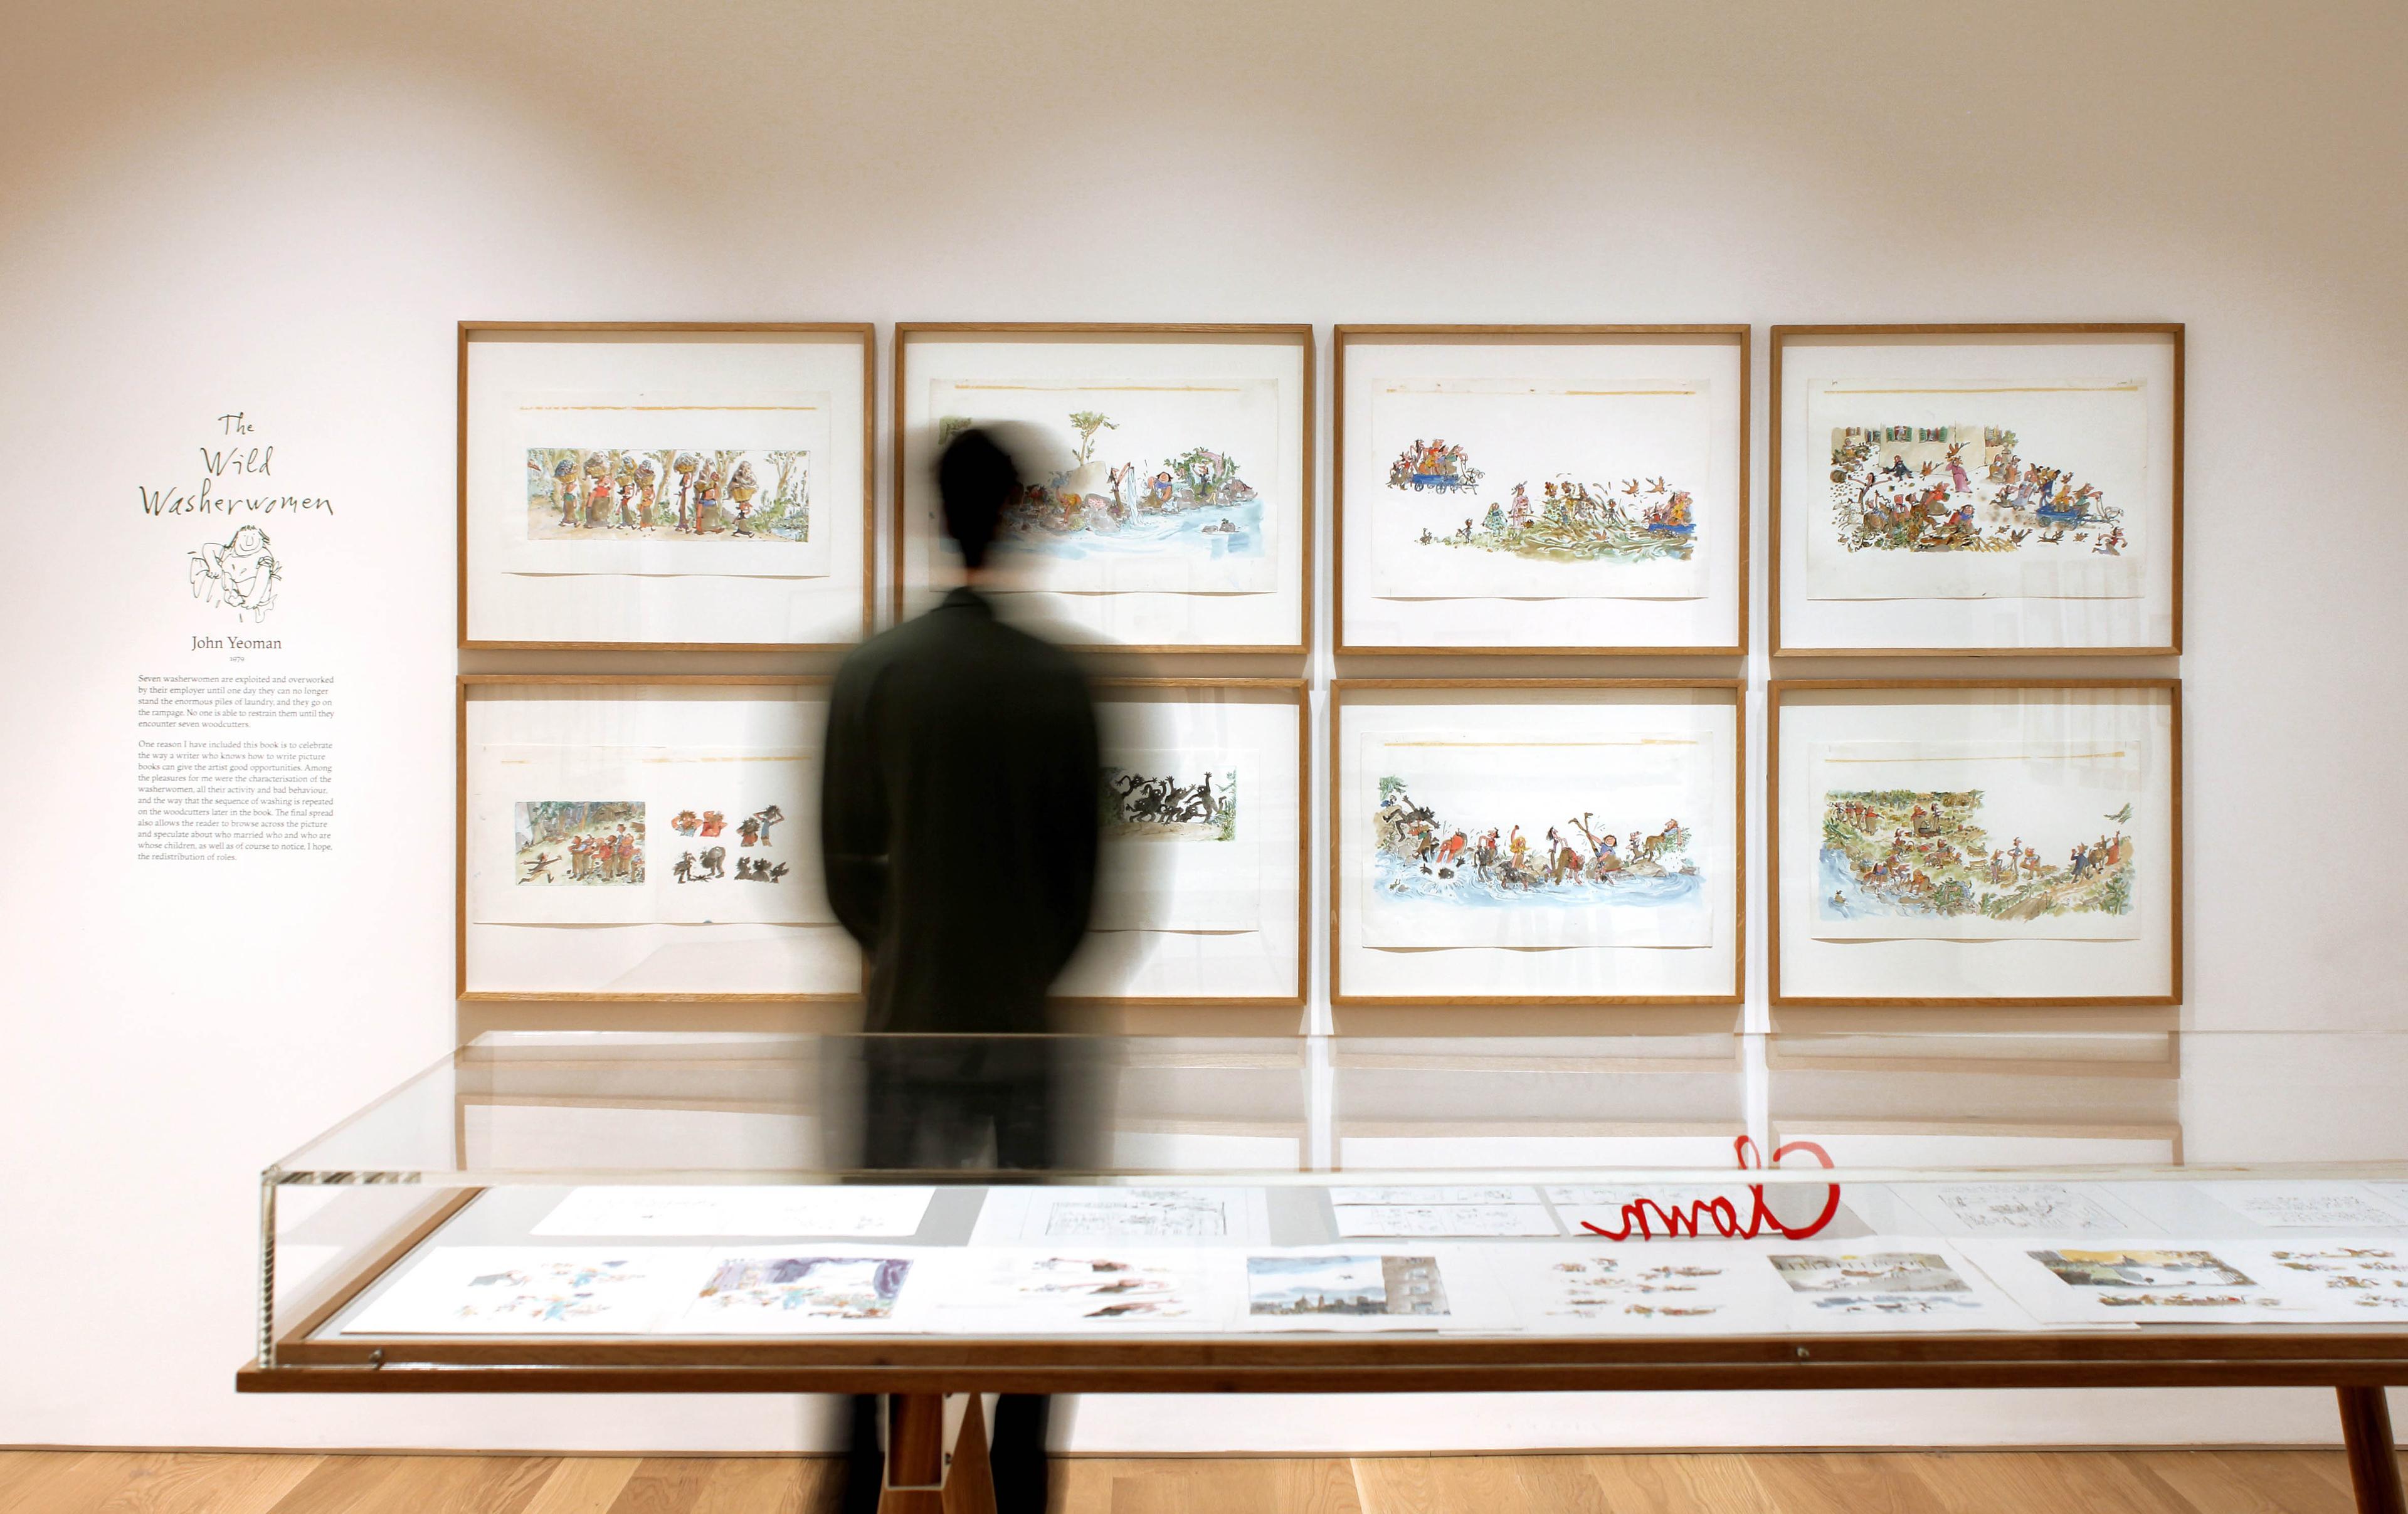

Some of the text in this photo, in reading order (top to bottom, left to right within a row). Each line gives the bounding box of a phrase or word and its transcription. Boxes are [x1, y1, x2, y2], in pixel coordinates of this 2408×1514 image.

[218, 411, 255, 435] The
[199, 446, 273, 476] Wild
[139, 478, 334, 517] Washerwomen
[191, 636, 283, 651] John Yeoman
[235, 676, 271, 685] exploited
[138, 686, 149, 695] by
[169, 686, 205, 695] employer
[243, 687, 256, 695] day
[258, 687, 275, 695] they
[304, 688, 329, 696] longer
[214, 698, 233, 707] piles
[292, 698, 310, 707] they
[318, 710, 335, 718] they
[229, 764, 248, 772] good
[151, 774, 187, 783] pleasures
[260, 798, 293, 806] washing
[302, 798, 334, 807] repeated
[309, 809, 334, 818] spread
[153, 831, 189, 839] speculate
